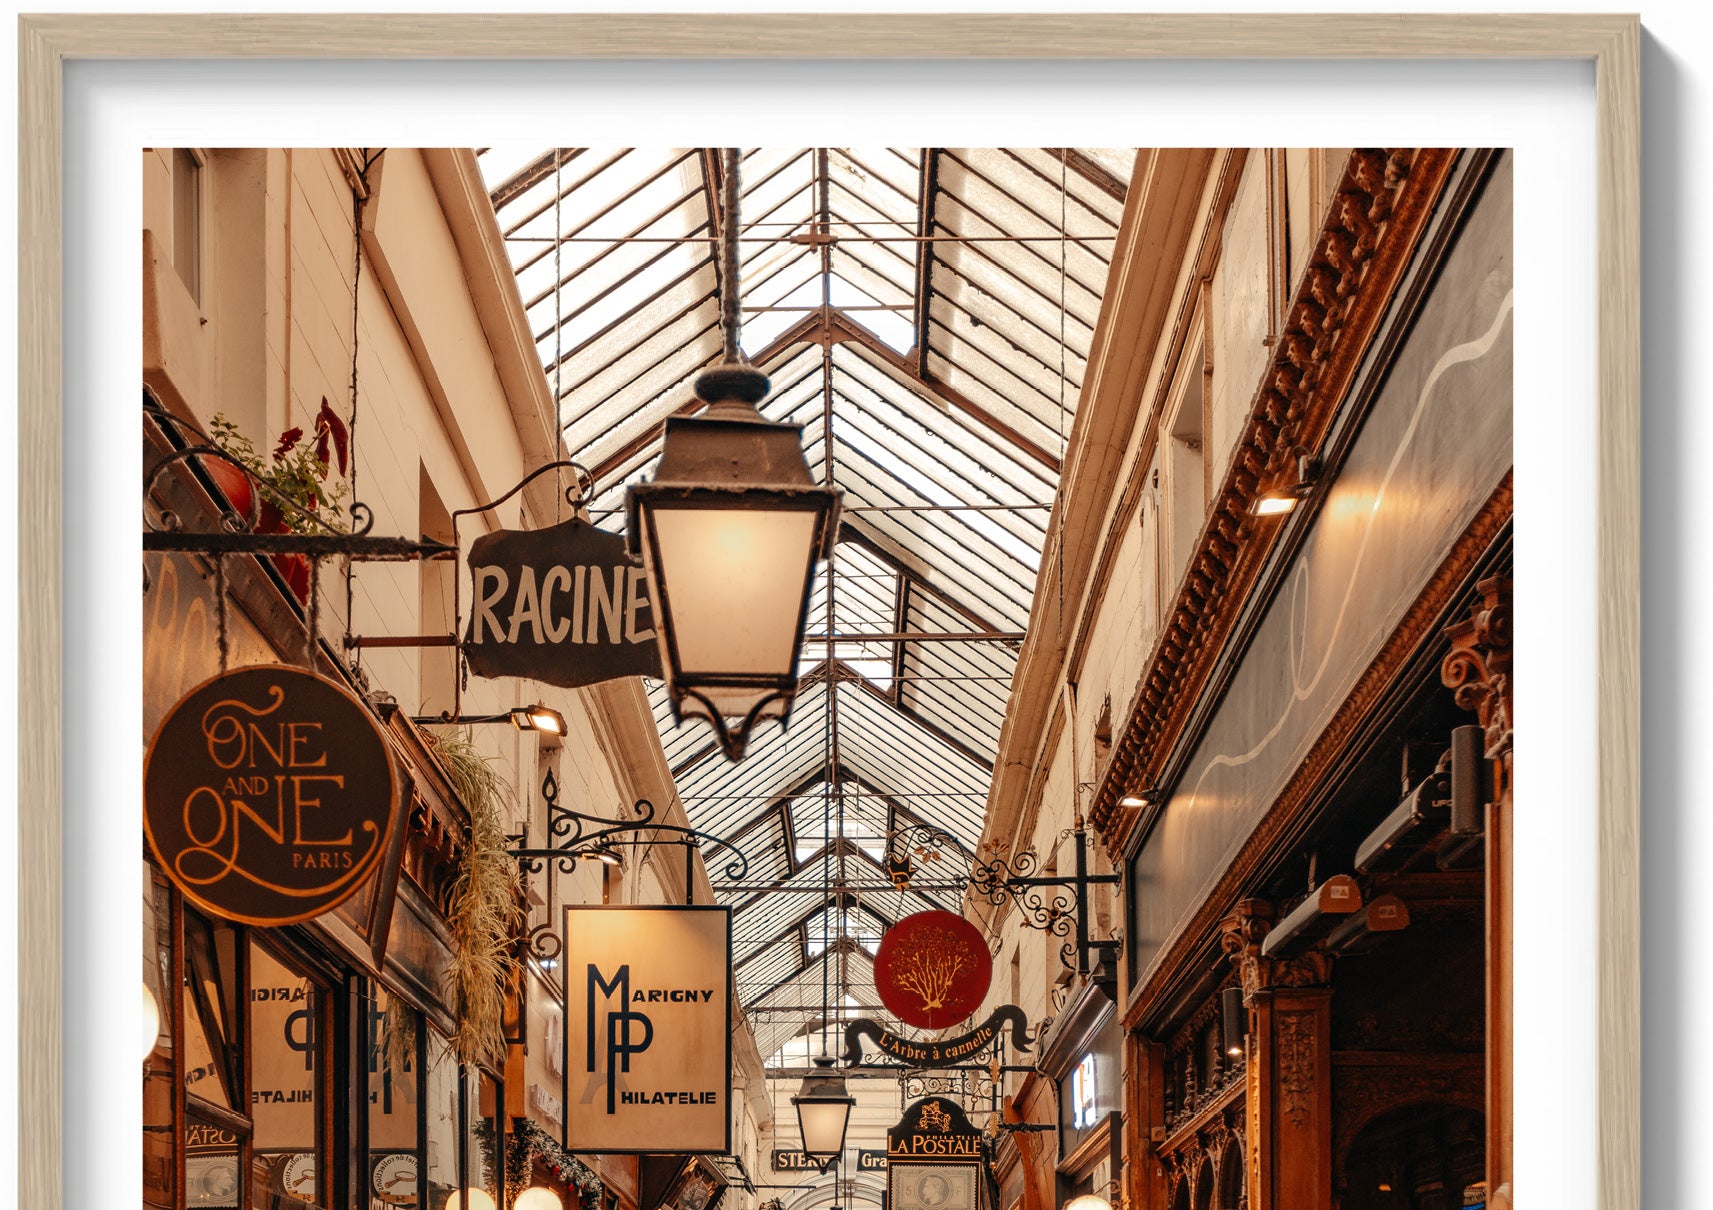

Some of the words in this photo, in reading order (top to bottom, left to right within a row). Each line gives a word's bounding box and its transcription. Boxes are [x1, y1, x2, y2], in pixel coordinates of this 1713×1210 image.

[202, 685, 327, 769] ONE
[222, 777, 269, 797] AND
[177, 775, 362, 885] ONE
[293, 852, 353, 870] PARIS
[932, 1046, 941, 1060] à
[944, 1026, 994, 1059] cannelle
[887, 1135, 909, 1154] LA
[912, 1135, 981, 1154] POSTALE
